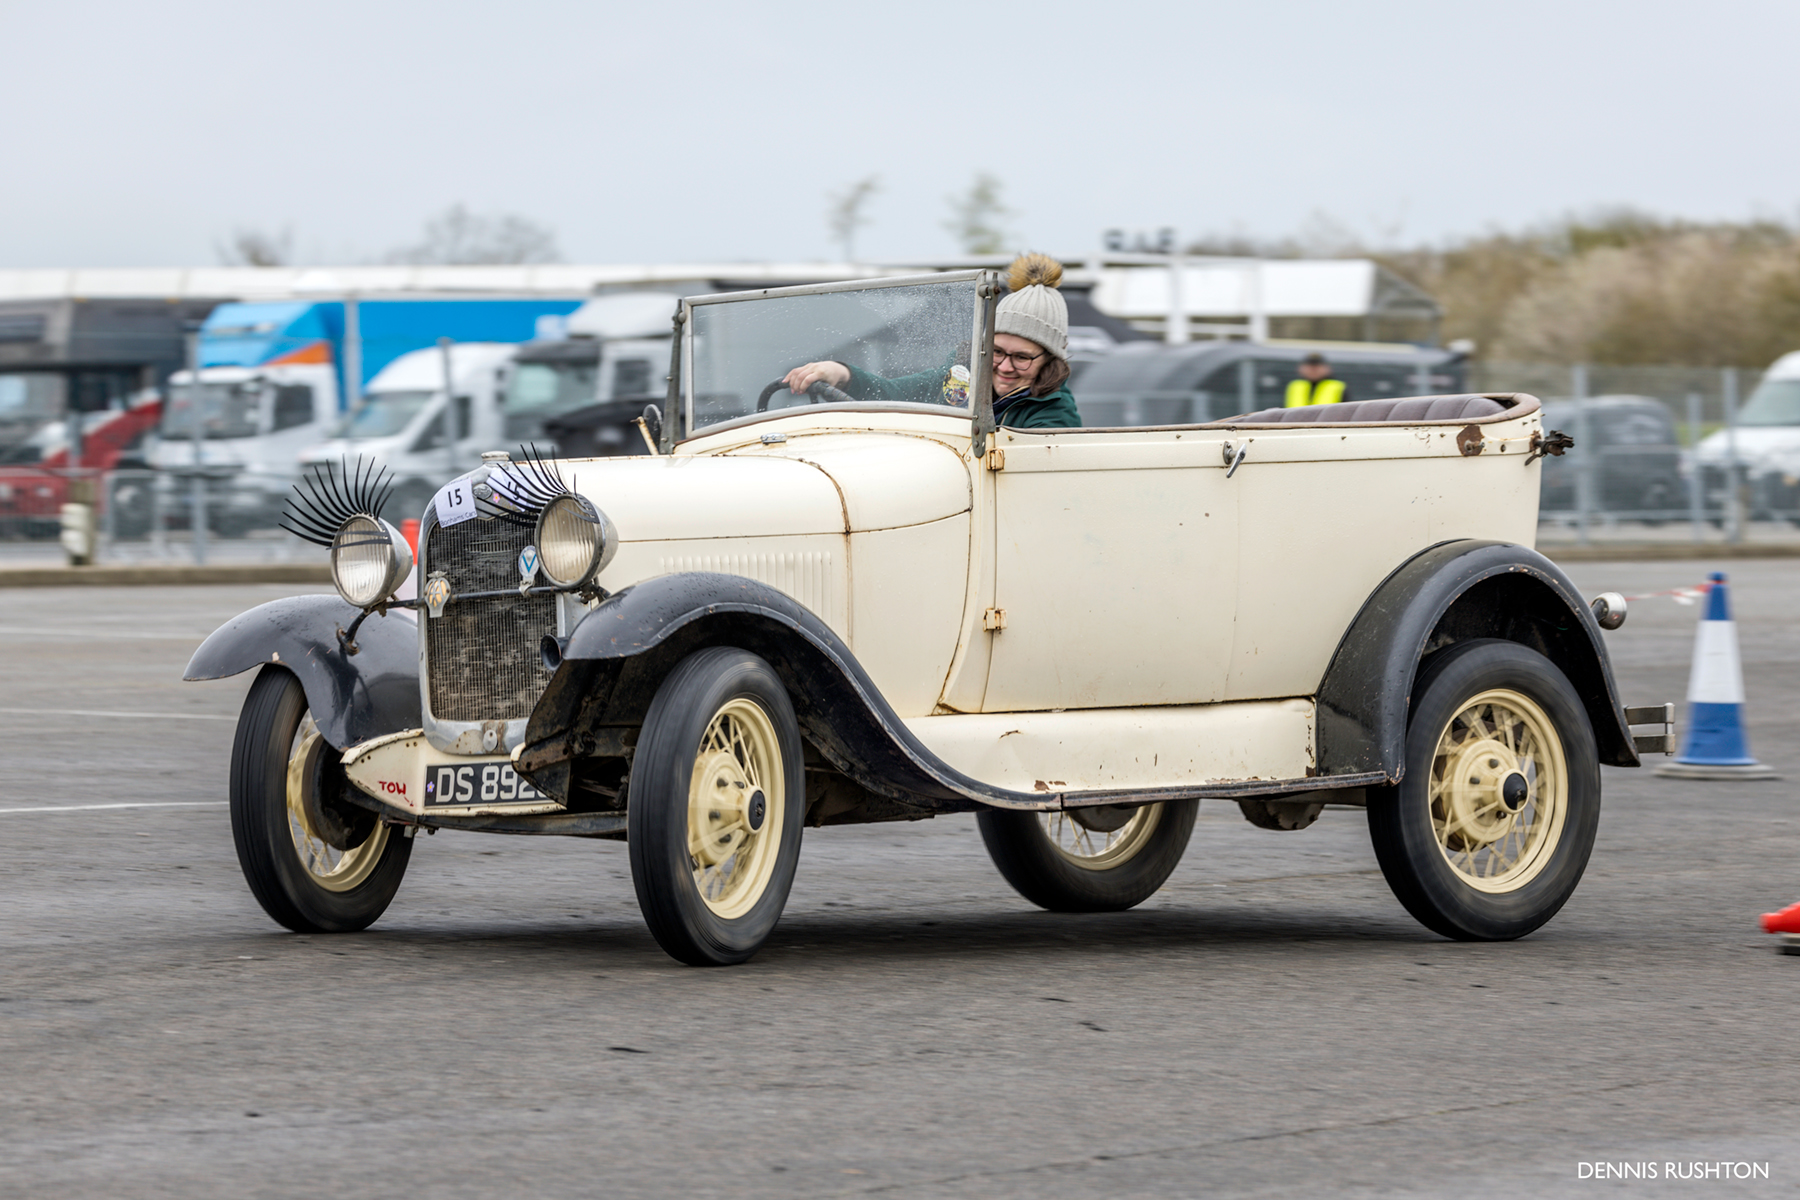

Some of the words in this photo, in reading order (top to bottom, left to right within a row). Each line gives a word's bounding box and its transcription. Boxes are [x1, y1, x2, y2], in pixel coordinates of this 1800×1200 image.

[448, 488, 462, 507] 15
[378, 781, 406, 795] TOW
[436, 767, 474, 802] DS
[481, 765, 547, 800] 892
